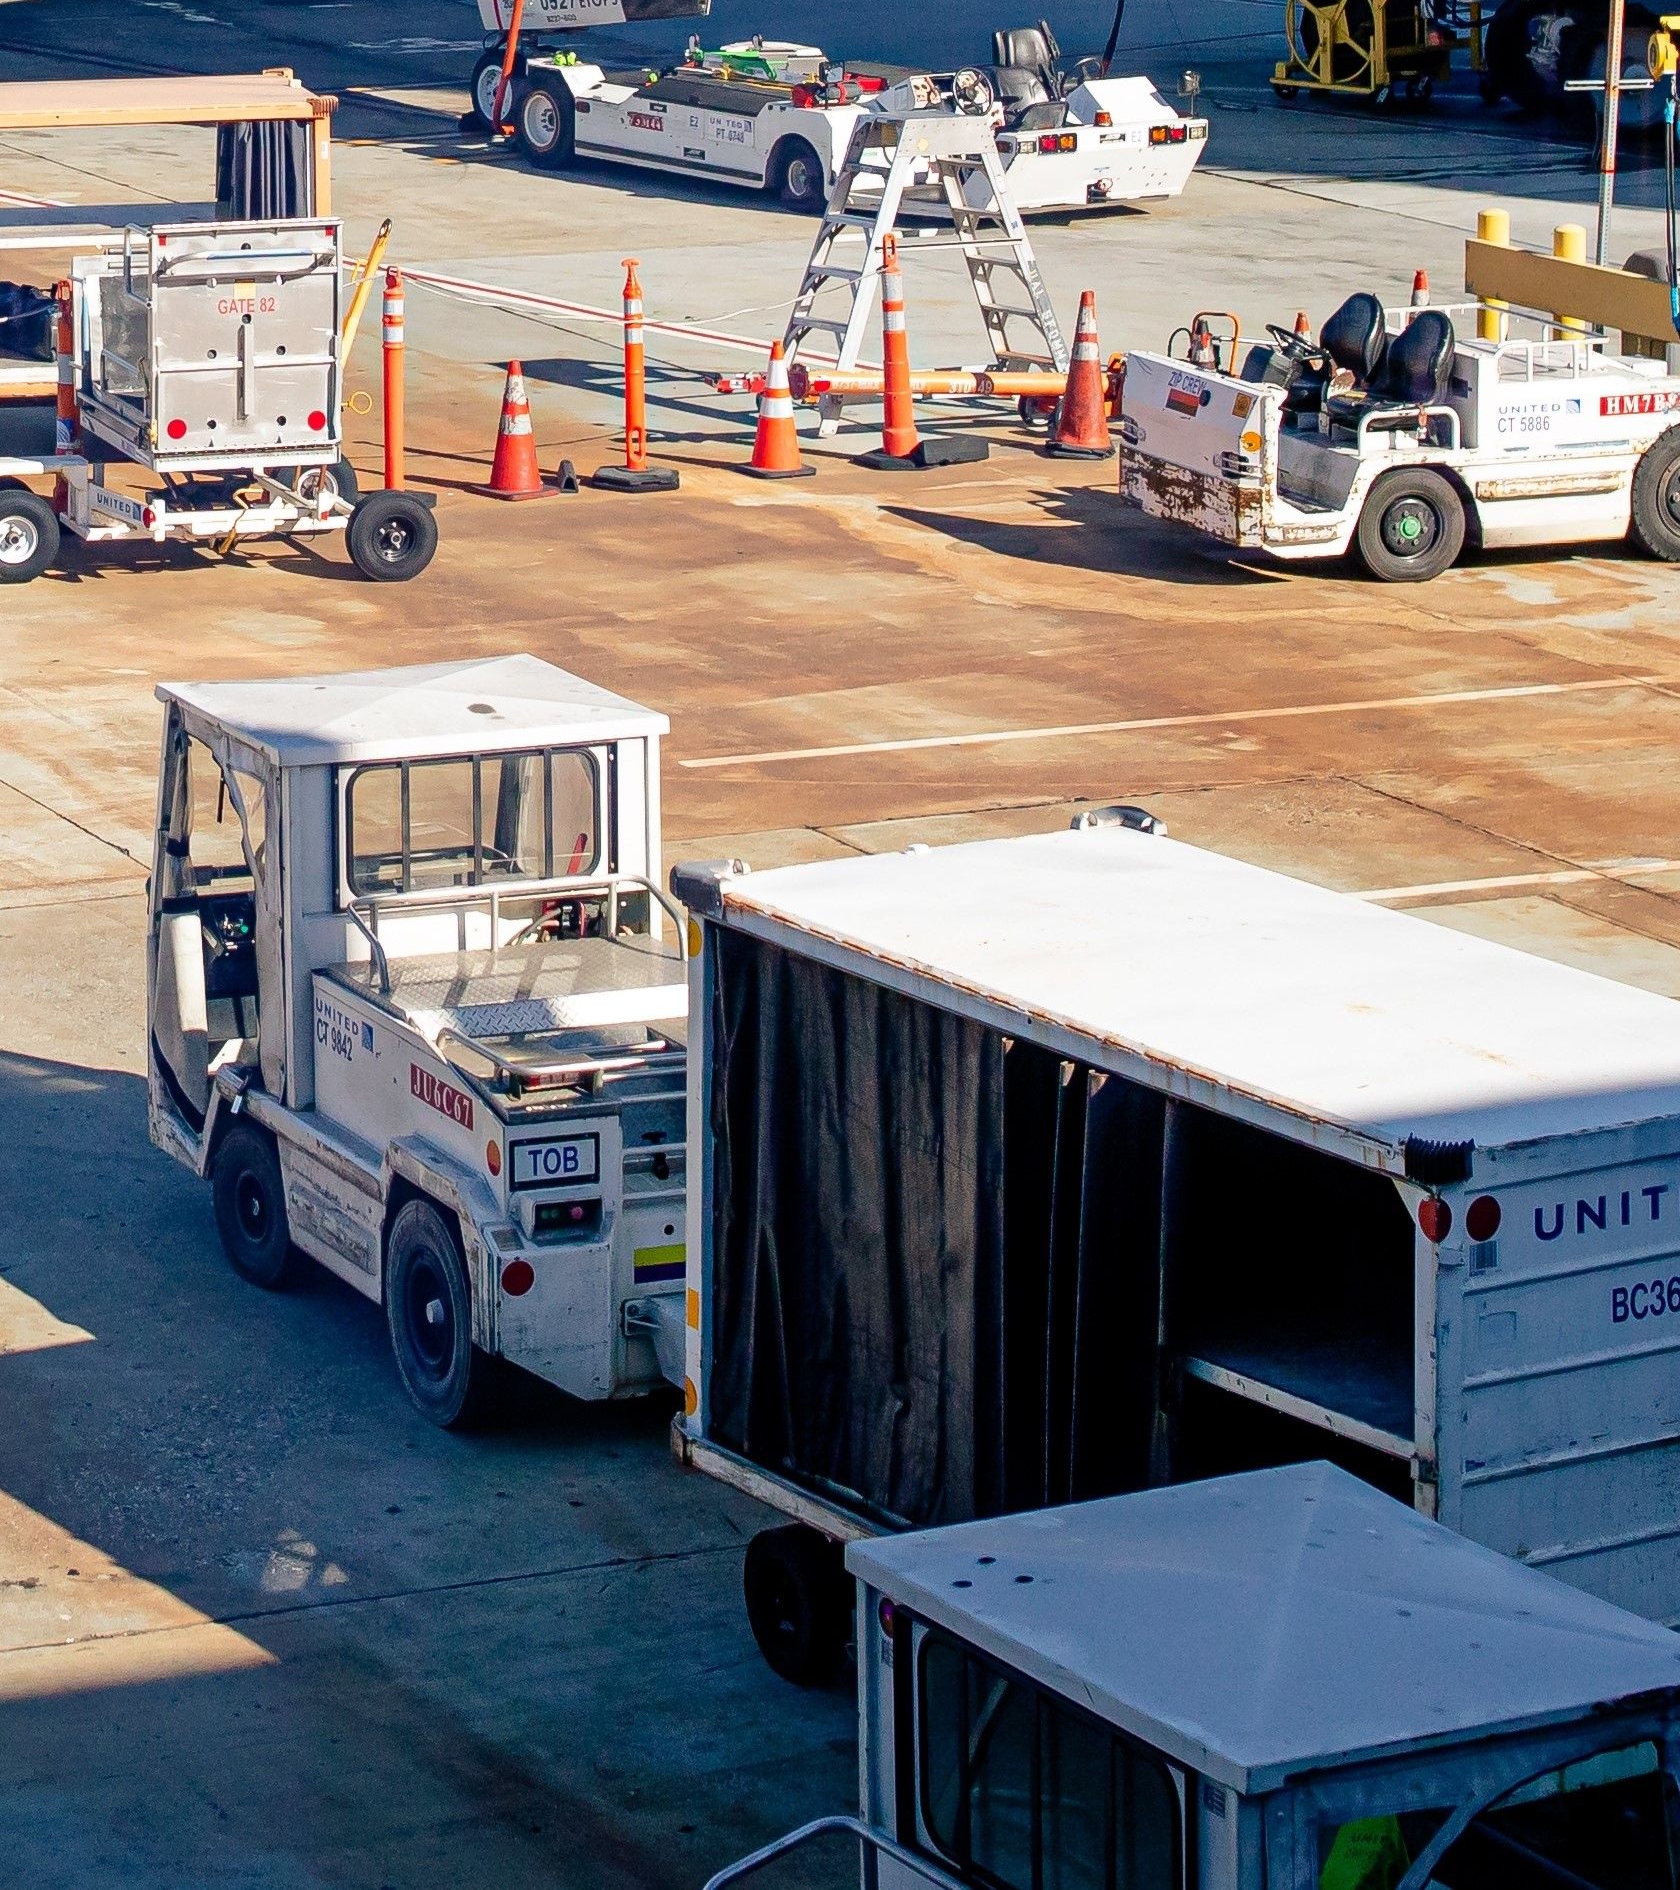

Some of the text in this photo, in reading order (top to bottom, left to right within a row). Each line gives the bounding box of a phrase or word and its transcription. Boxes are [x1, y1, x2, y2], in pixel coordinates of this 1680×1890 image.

[217, 297, 276, 315] GATE 82
[1168, 371, 1183, 388] ZIP
[1498, 403, 1561, 416] UNITED
[1497, 415, 1551, 434] CT 5886
[96, 492, 132, 514] UNITED
[315, 997, 360, 1036] UNITED
[316, 1018, 353, 1062] CT 9842
[413, 1067, 471, 1126] JU6C67
[527, 1145, 580, 1177] TOB
